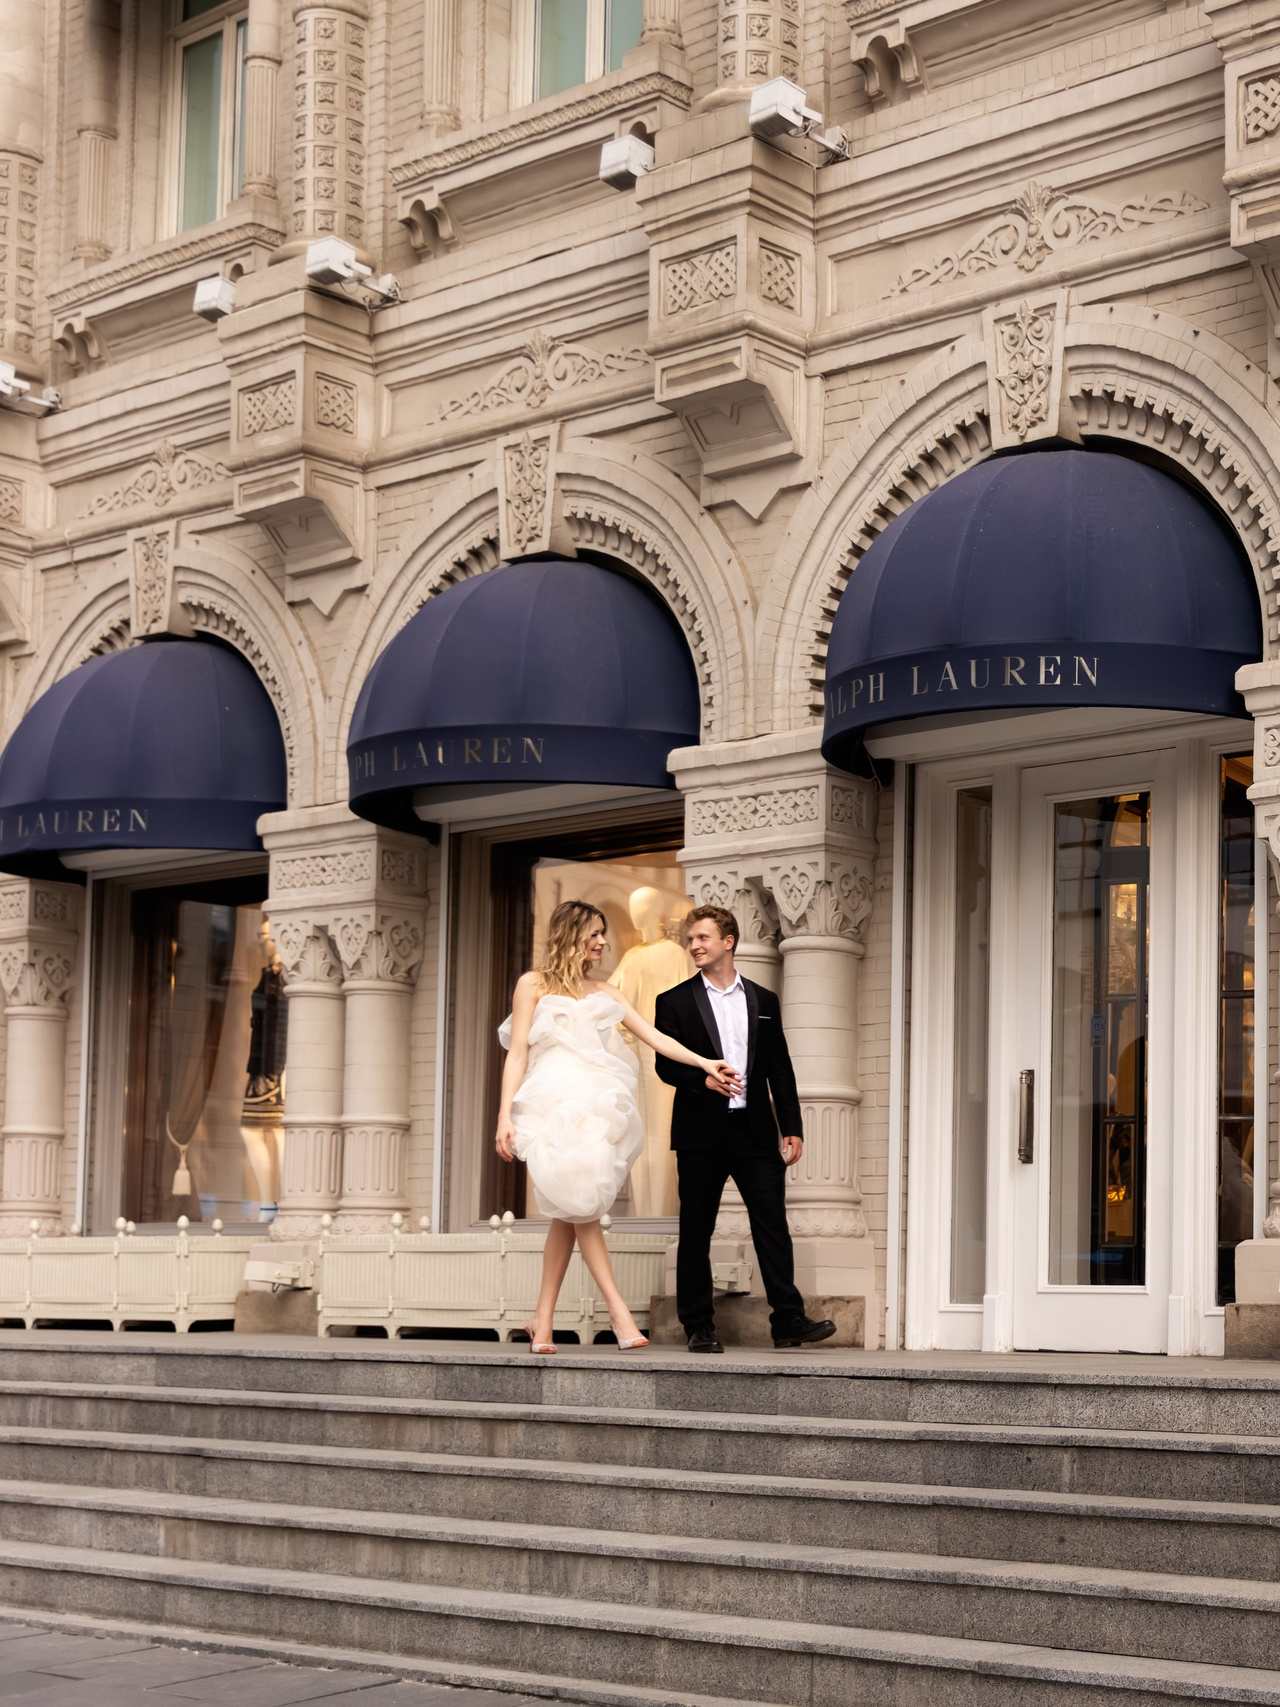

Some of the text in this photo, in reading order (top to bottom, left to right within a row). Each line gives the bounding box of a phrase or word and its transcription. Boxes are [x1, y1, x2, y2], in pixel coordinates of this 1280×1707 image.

[911, 655, 1100, 696] LAUREN
[393, 737, 546, 772] LAUREN
[18, 808, 150, 838] LAUREN
